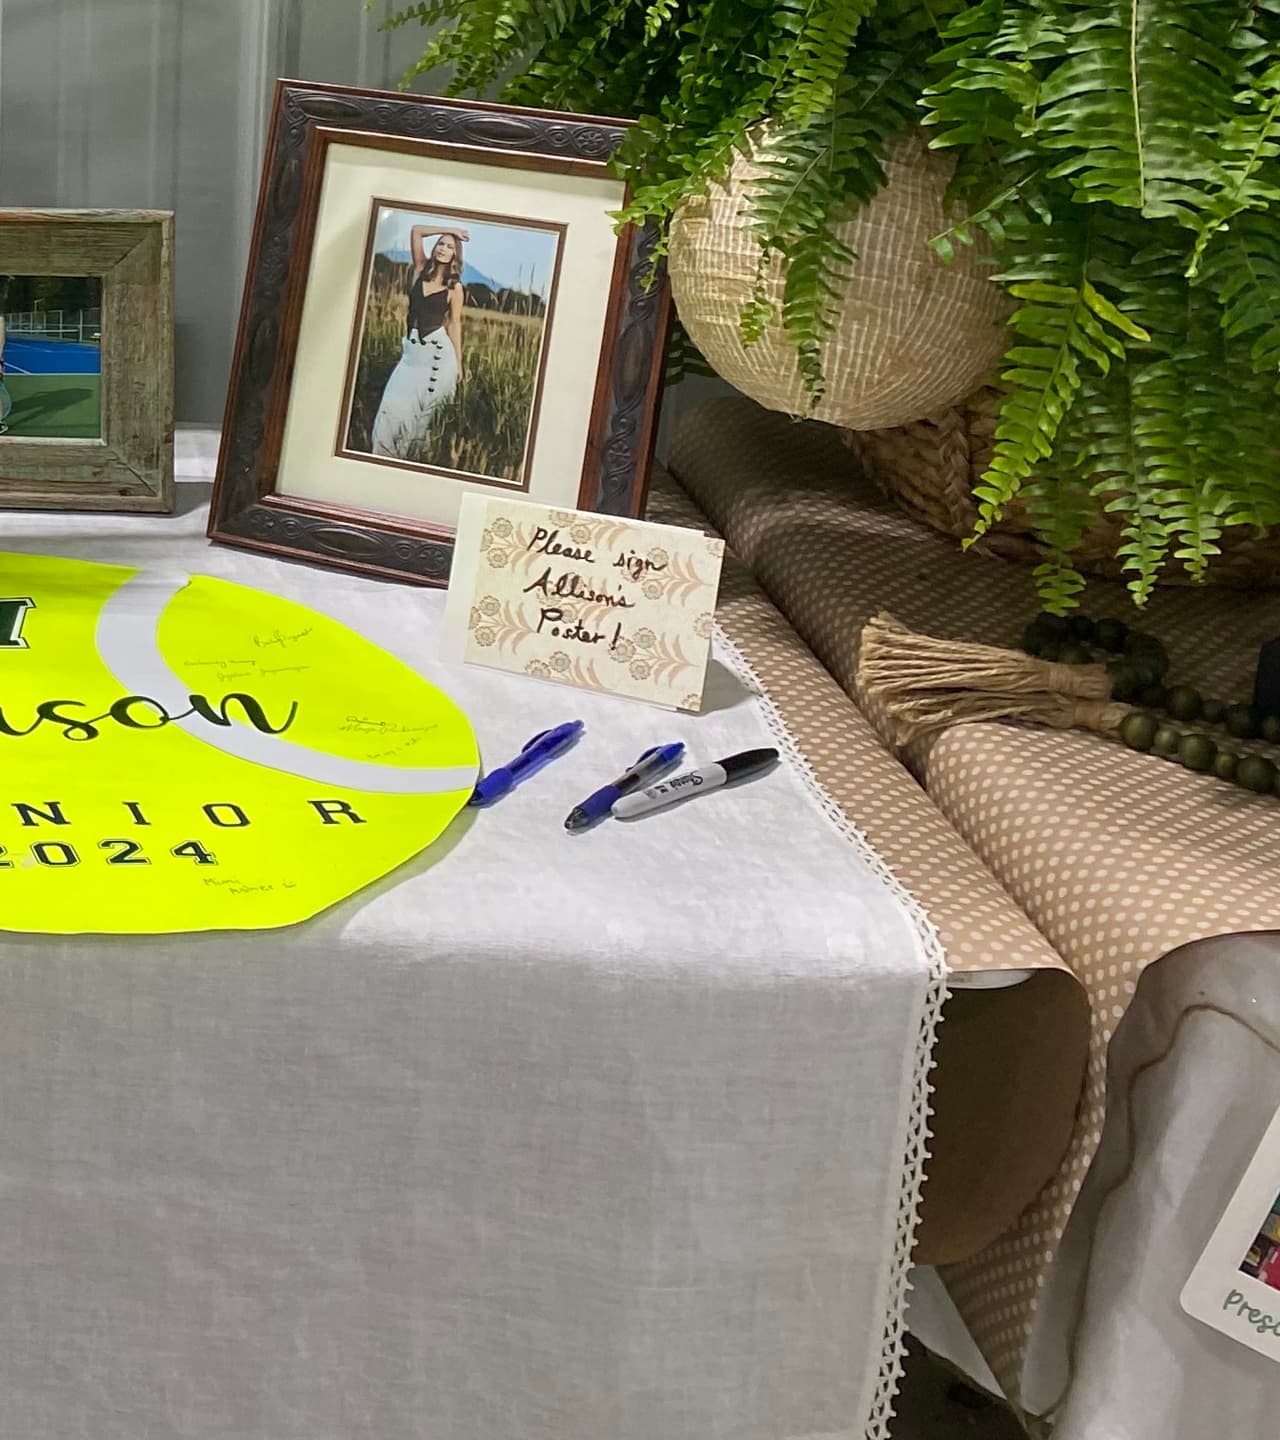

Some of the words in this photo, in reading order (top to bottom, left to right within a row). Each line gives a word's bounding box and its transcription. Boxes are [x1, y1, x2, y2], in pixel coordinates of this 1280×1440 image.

[527, 525, 596, 564] Please
[612, 549, 669, 581] sign
[523, 566, 636, 609] Allison's
